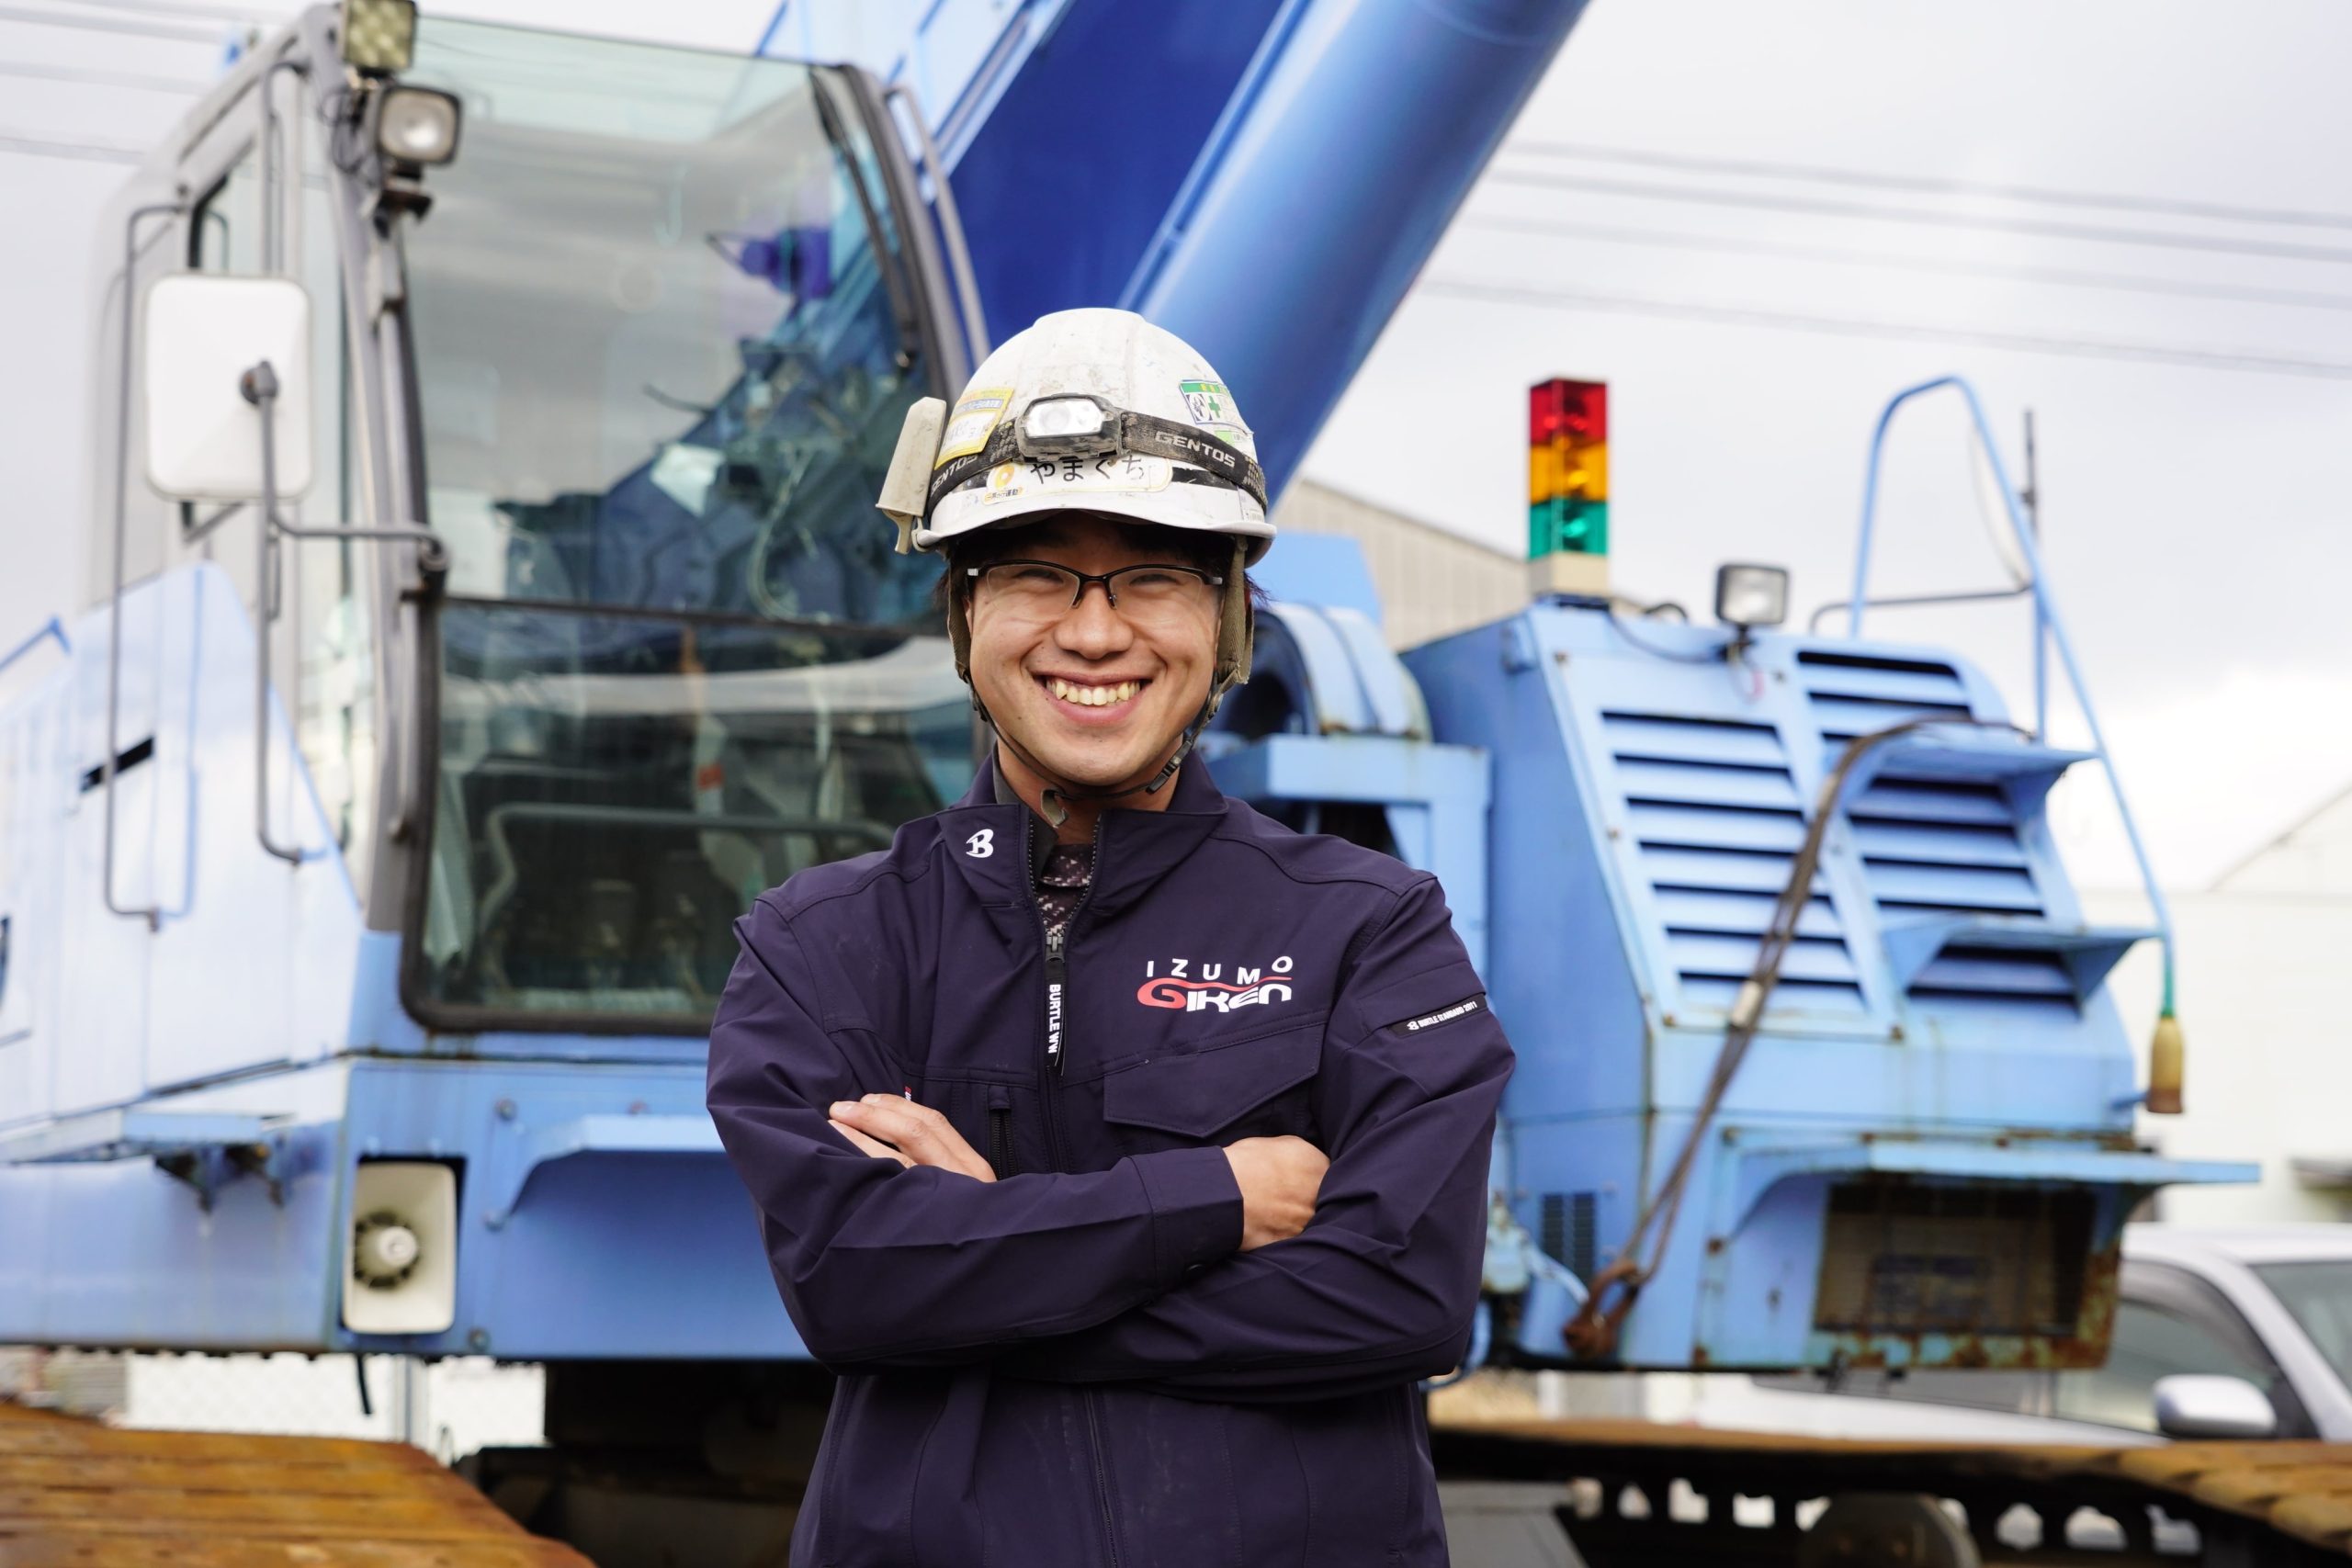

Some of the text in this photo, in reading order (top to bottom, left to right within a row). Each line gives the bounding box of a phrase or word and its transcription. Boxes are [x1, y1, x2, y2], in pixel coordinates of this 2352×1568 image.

[1155, 431, 1236, 468] GENTOS
[966, 829, 994, 858] B
[1147, 955, 1294, 985] IZUMO
[1049, 984, 1061, 1032] BURTLE
